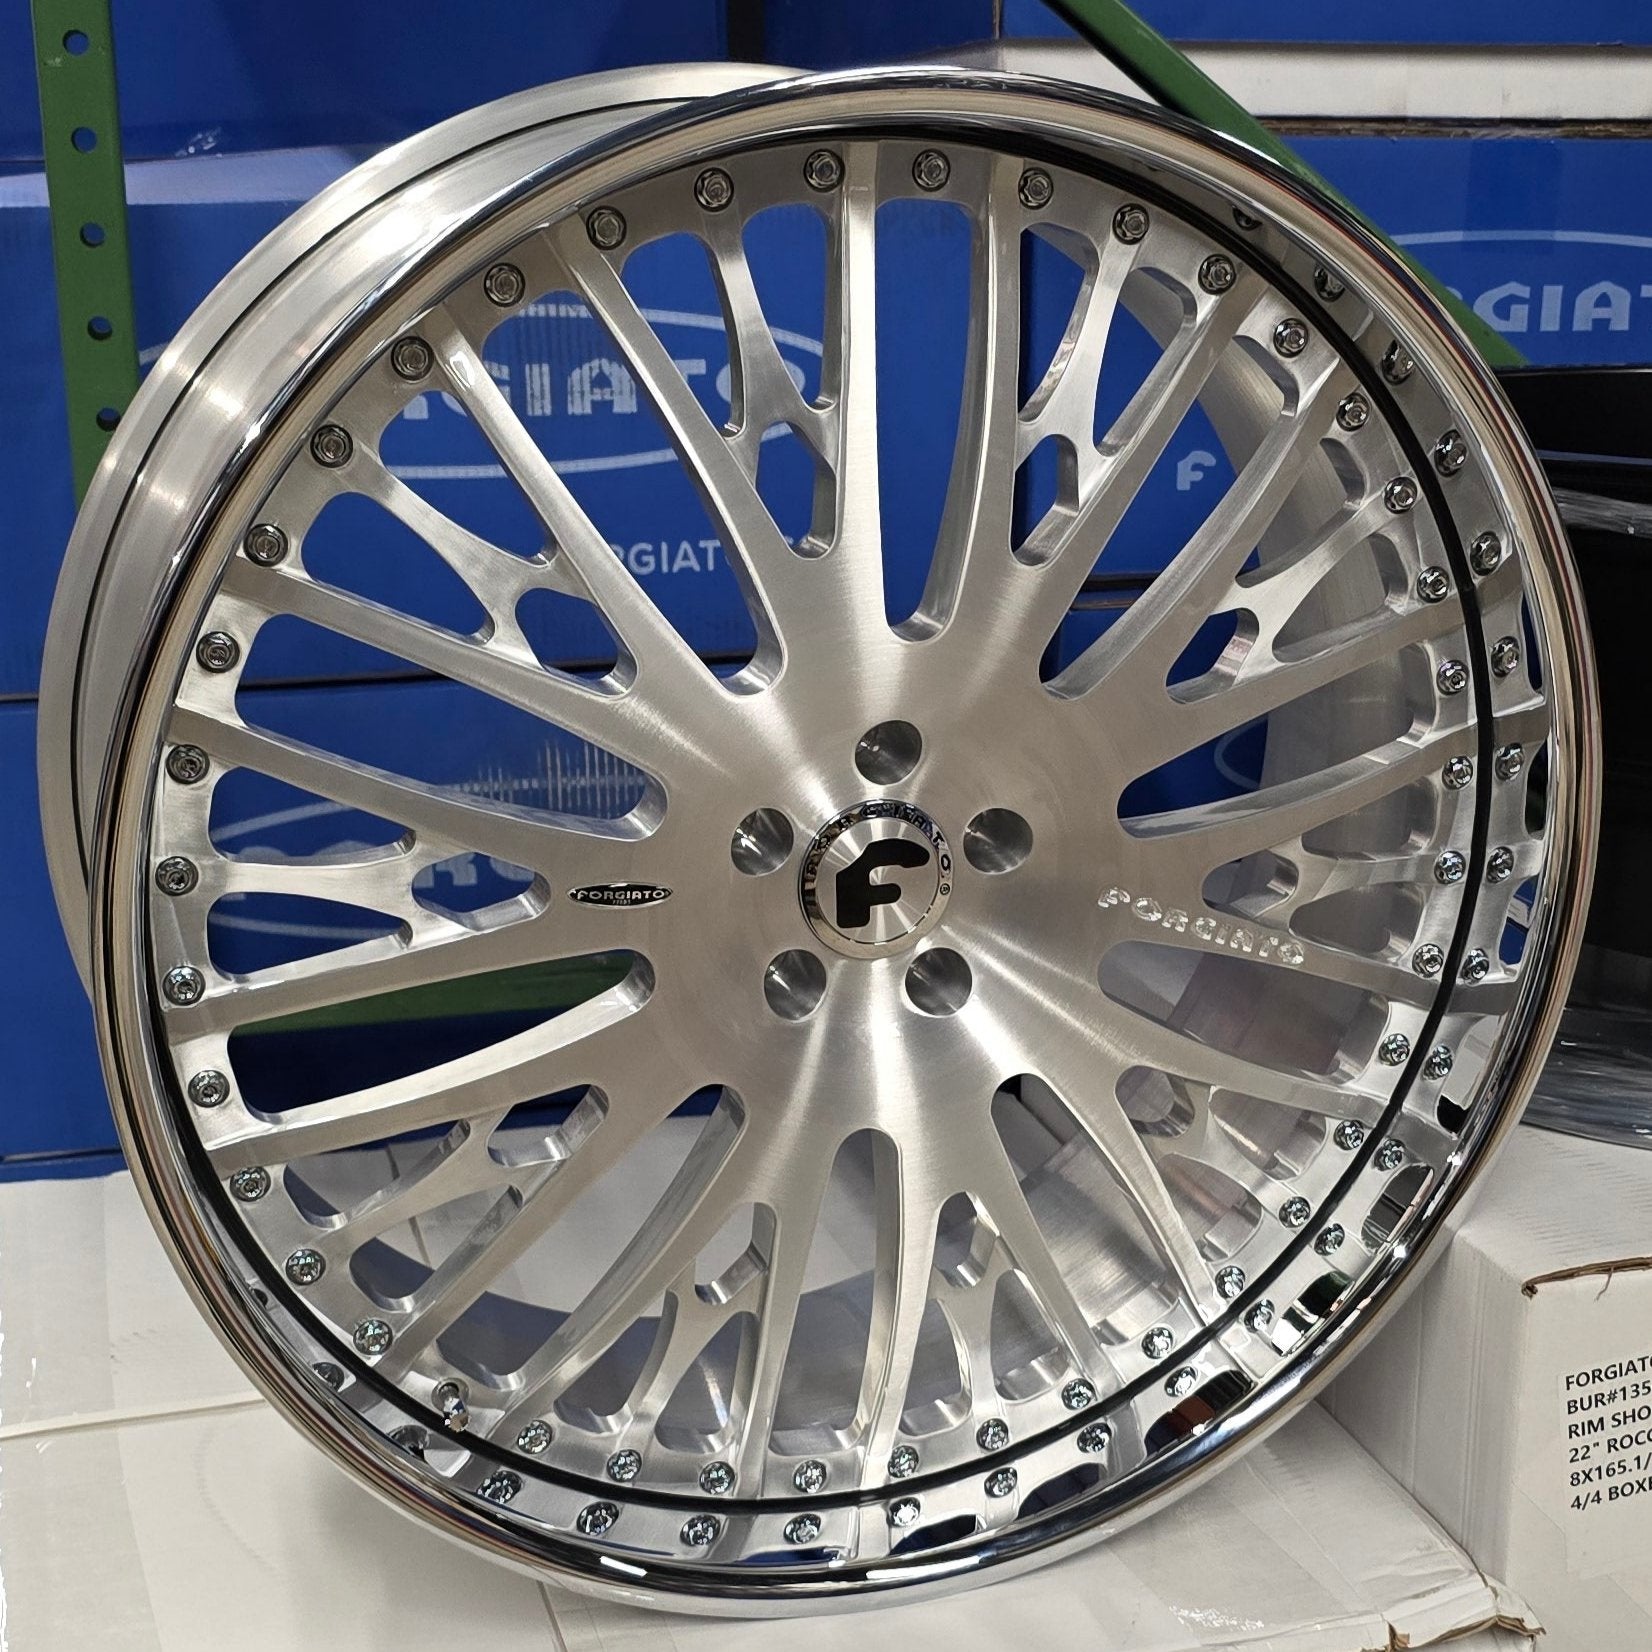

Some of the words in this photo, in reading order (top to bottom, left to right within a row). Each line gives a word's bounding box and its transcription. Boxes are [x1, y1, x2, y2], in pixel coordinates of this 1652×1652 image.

[1447, 281, 1652, 332] GIA
[1176, 450, 1217, 491] F
[610, 539, 732, 575] GIAT
[577, 889, 666, 900] FORGIATO
[1565, 1355, 1652, 1391] FORGIAT
[1568, 1417, 1605, 1439] RIM
[1569, 1442, 1600, 1463] 22"
[1571, 1490, 1602, 1511] 4/4
